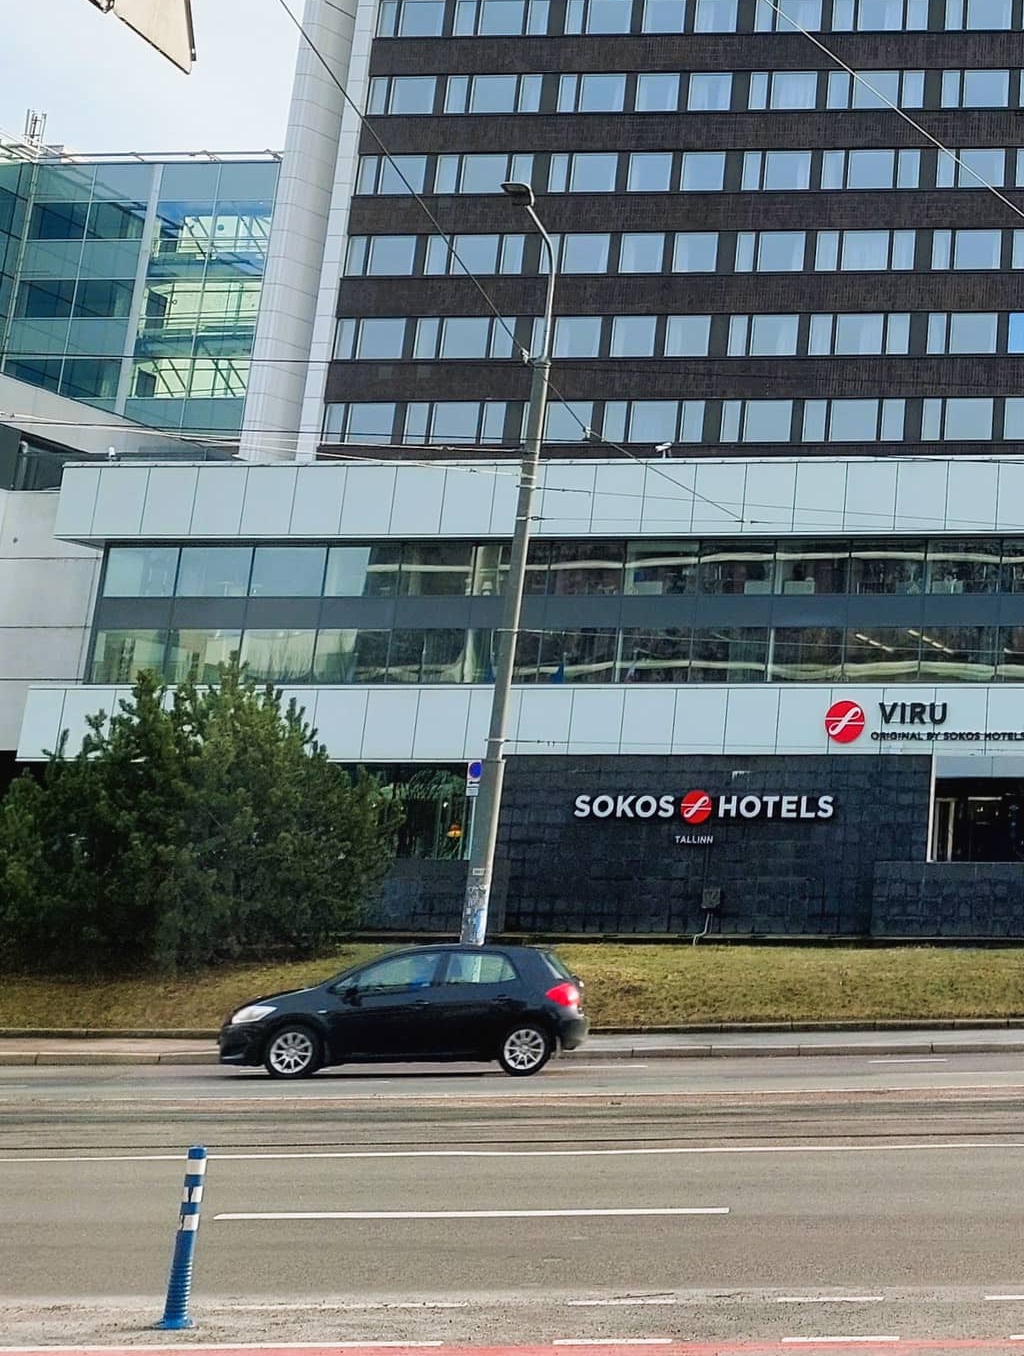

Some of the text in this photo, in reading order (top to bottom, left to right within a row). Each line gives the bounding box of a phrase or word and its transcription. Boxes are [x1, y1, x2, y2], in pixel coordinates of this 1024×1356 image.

[878, 702, 947, 725] VIRU
[870, 731, 1024, 742] ORIGINAL BY SOKOS HOTELS
[573, 795, 835, 818] SOKOS HOTELS
[675, 835, 714, 844] TALLINN
